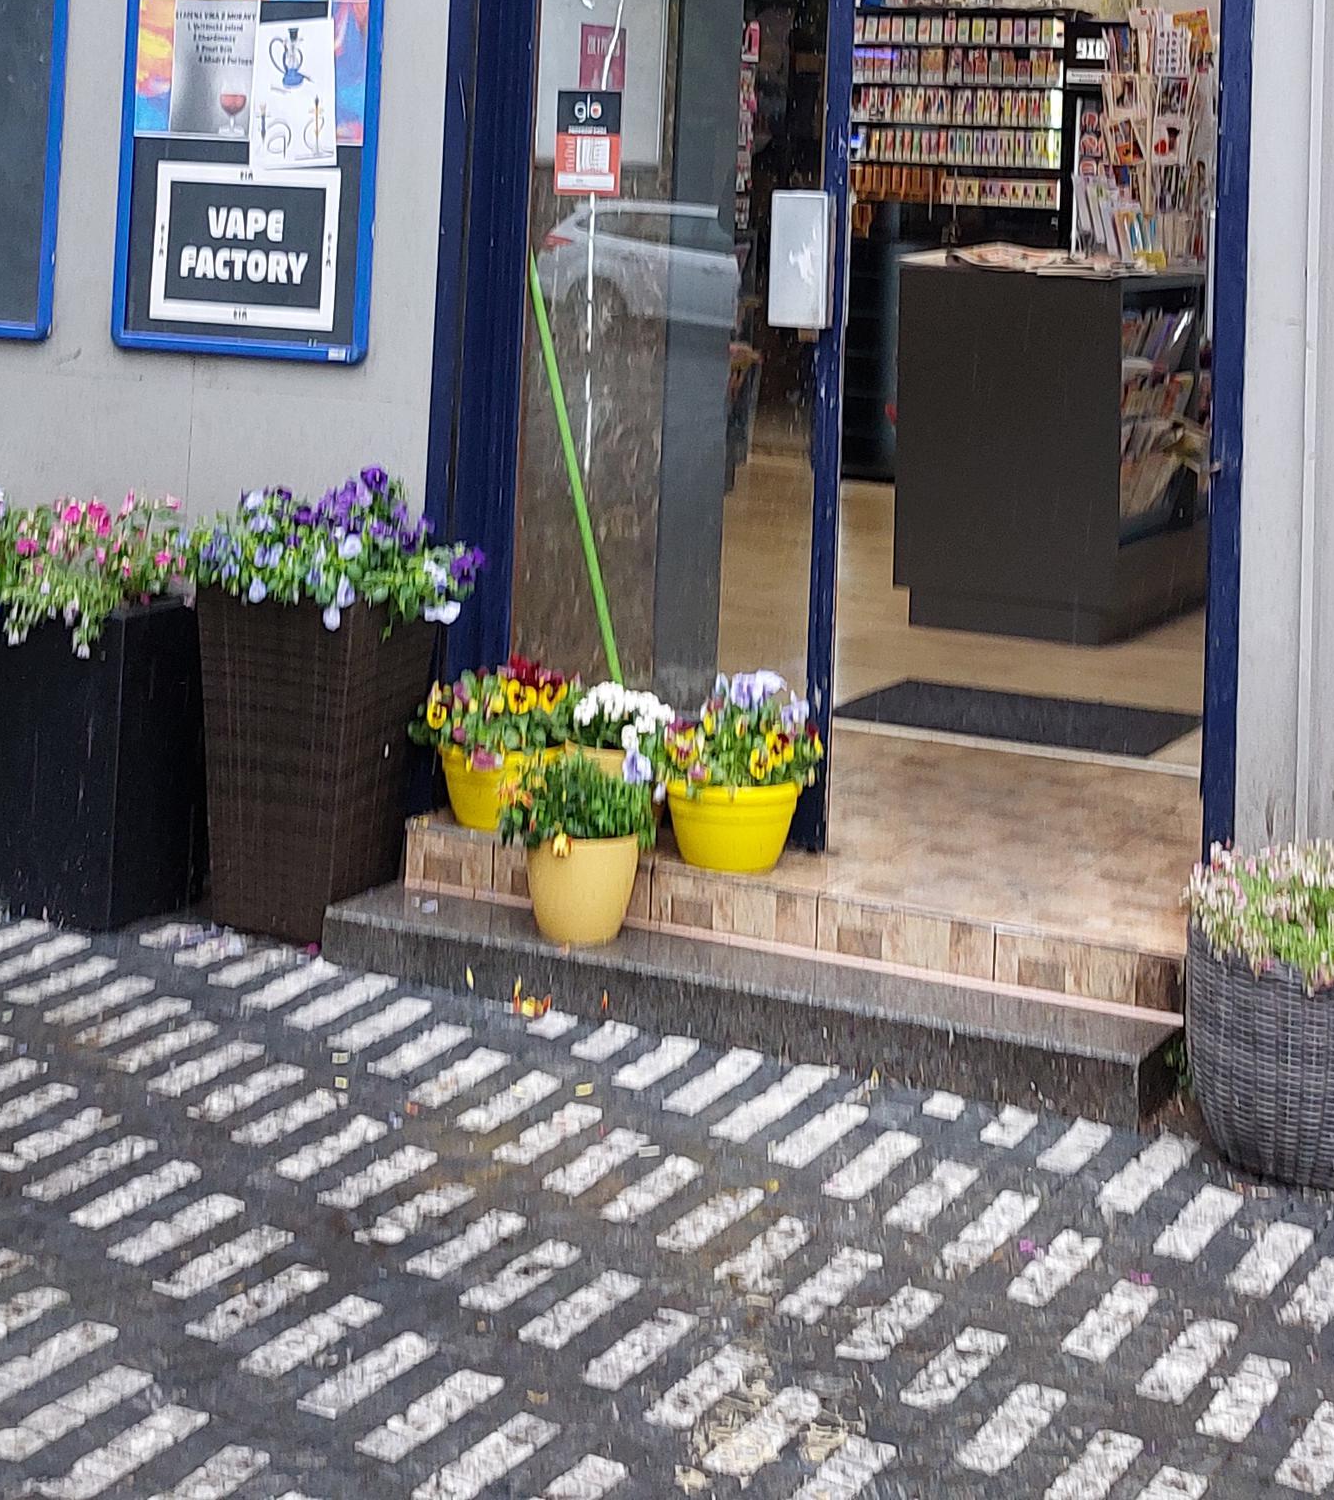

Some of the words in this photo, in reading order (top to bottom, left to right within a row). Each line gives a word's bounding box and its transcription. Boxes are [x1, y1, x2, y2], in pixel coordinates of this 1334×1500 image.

[574, 93, 602, 124] glo
[207, 205, 285, 242] VAPE
[179, 244, 309, 285] FACTORY
